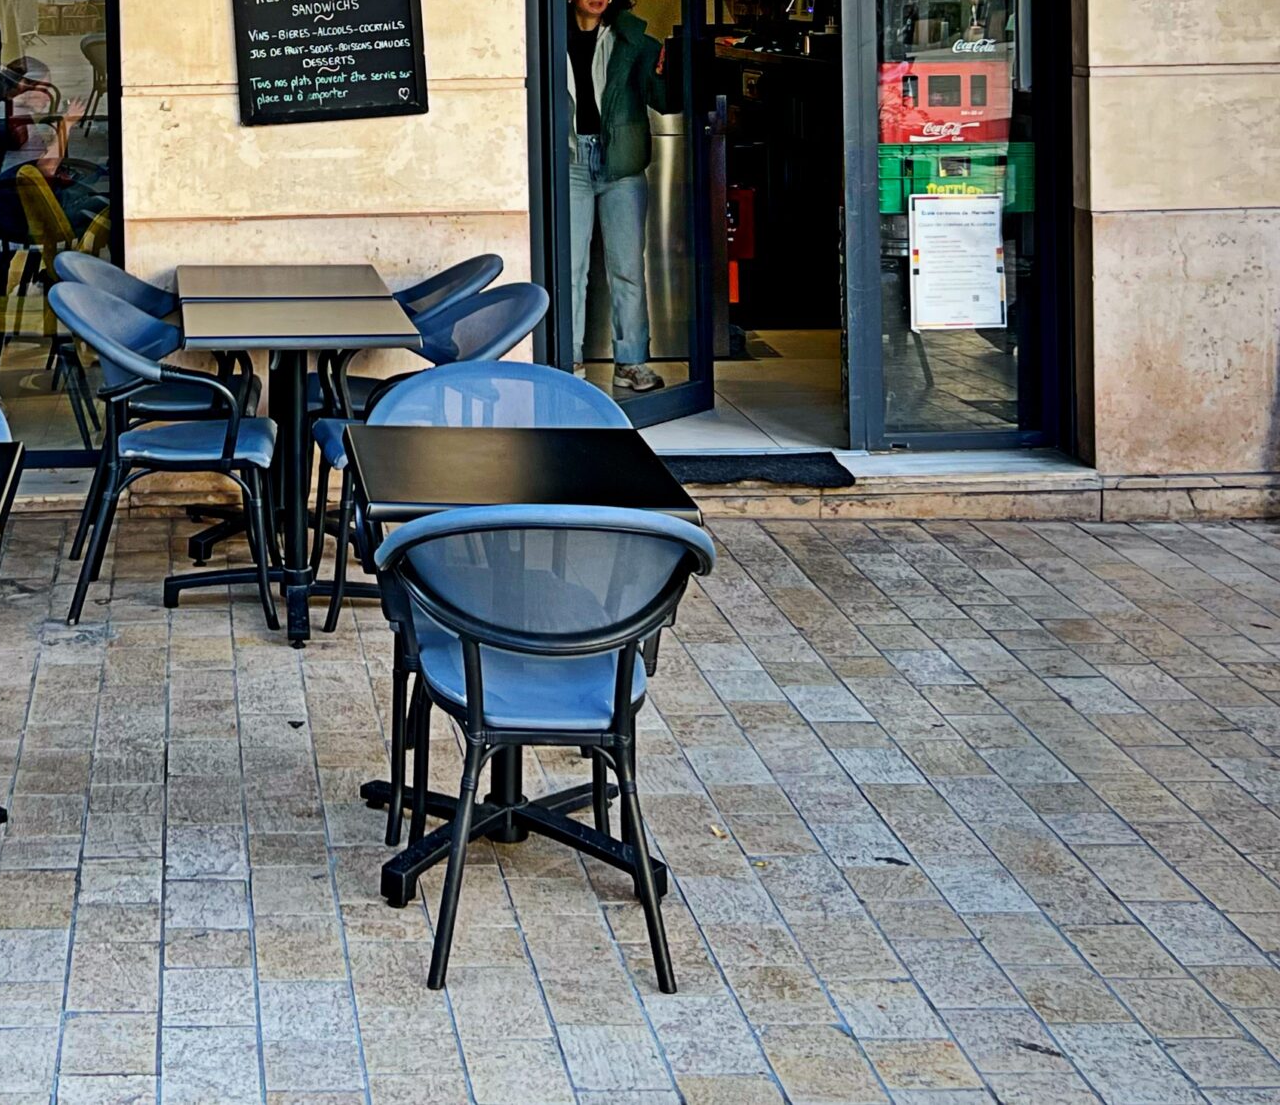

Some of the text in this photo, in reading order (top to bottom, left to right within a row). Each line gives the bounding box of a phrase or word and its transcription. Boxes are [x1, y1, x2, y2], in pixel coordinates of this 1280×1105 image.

[249, 49, 267, 59] JUS
[270, 47, 282, 57] DE
[302, 55, 356, 68] DESSERTS
[274, 79, 289, 88] nos
[370, 70, 397, 81] servis
[257, 92, 280, 111] place
